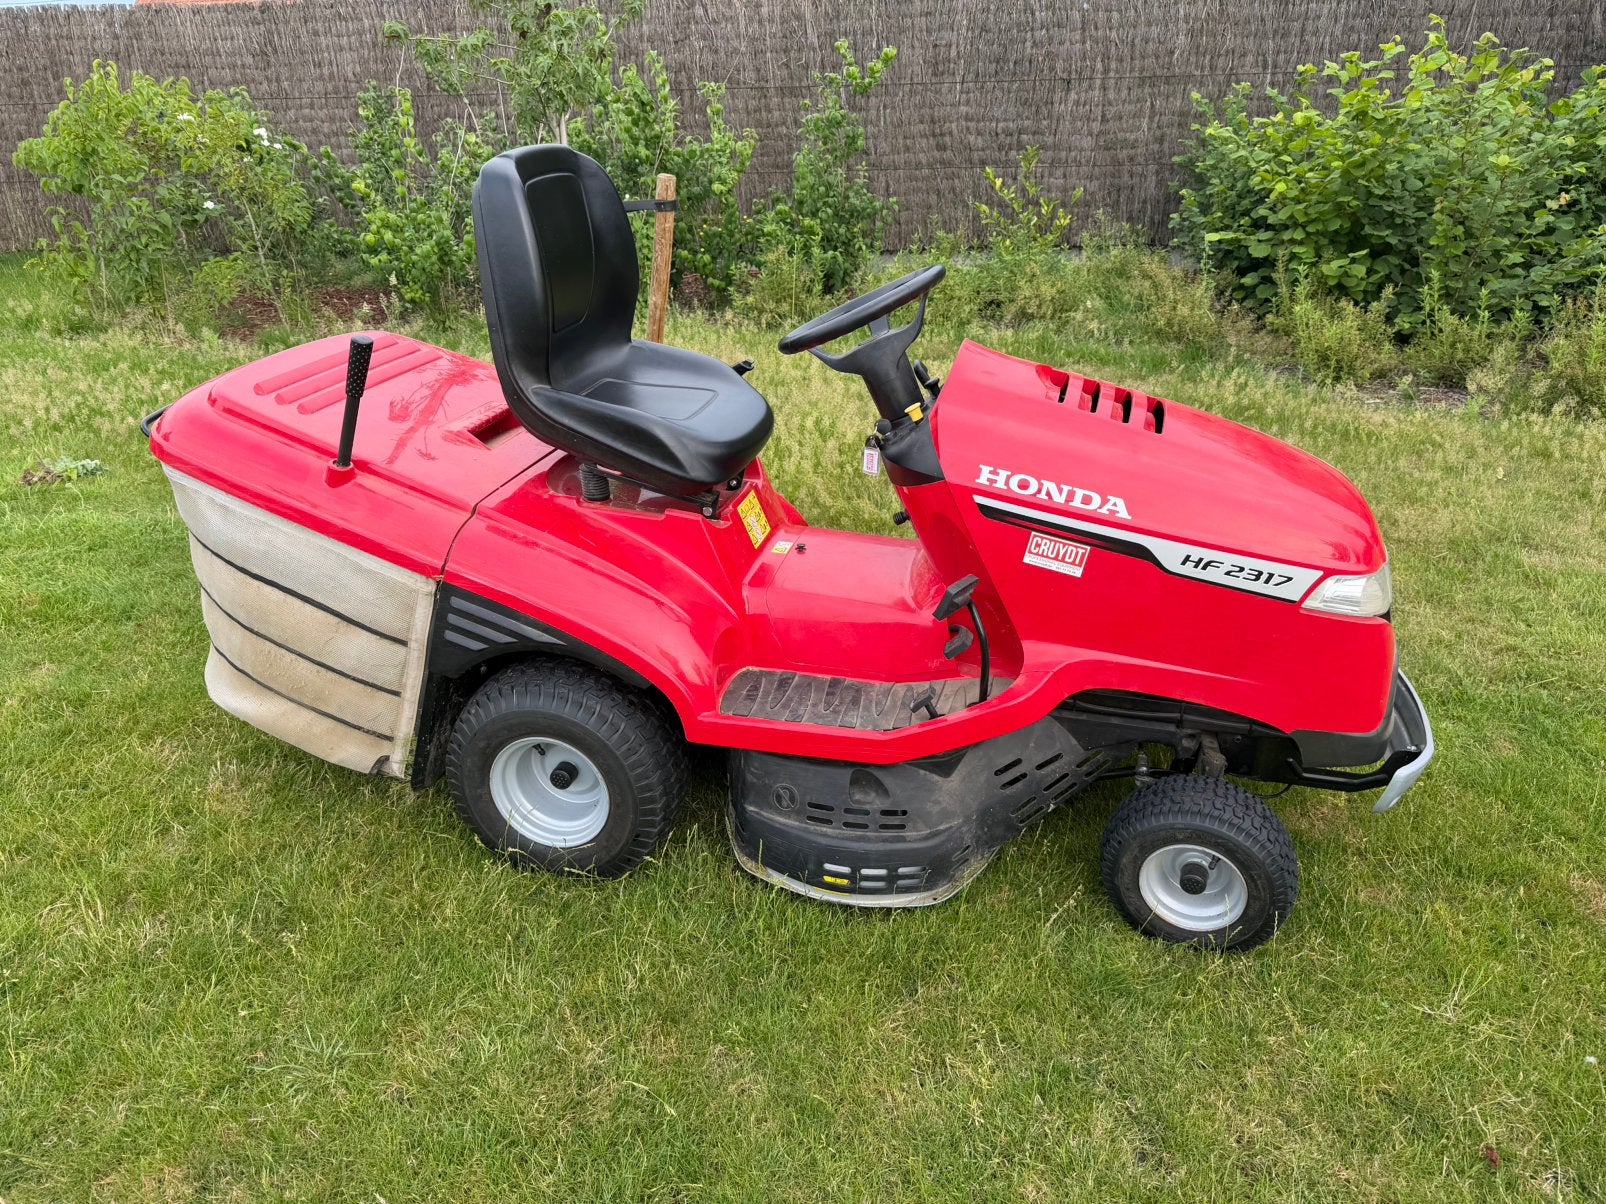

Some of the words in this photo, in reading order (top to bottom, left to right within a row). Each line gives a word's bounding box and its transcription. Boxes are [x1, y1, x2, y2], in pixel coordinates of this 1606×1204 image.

[975, 464, 1132, 519] HONDA
[1031, 537, 1086, 565] CRUYDT
[1180, 554, 1224, 571] HF
[1224, 564, 1294, 587] 2317
